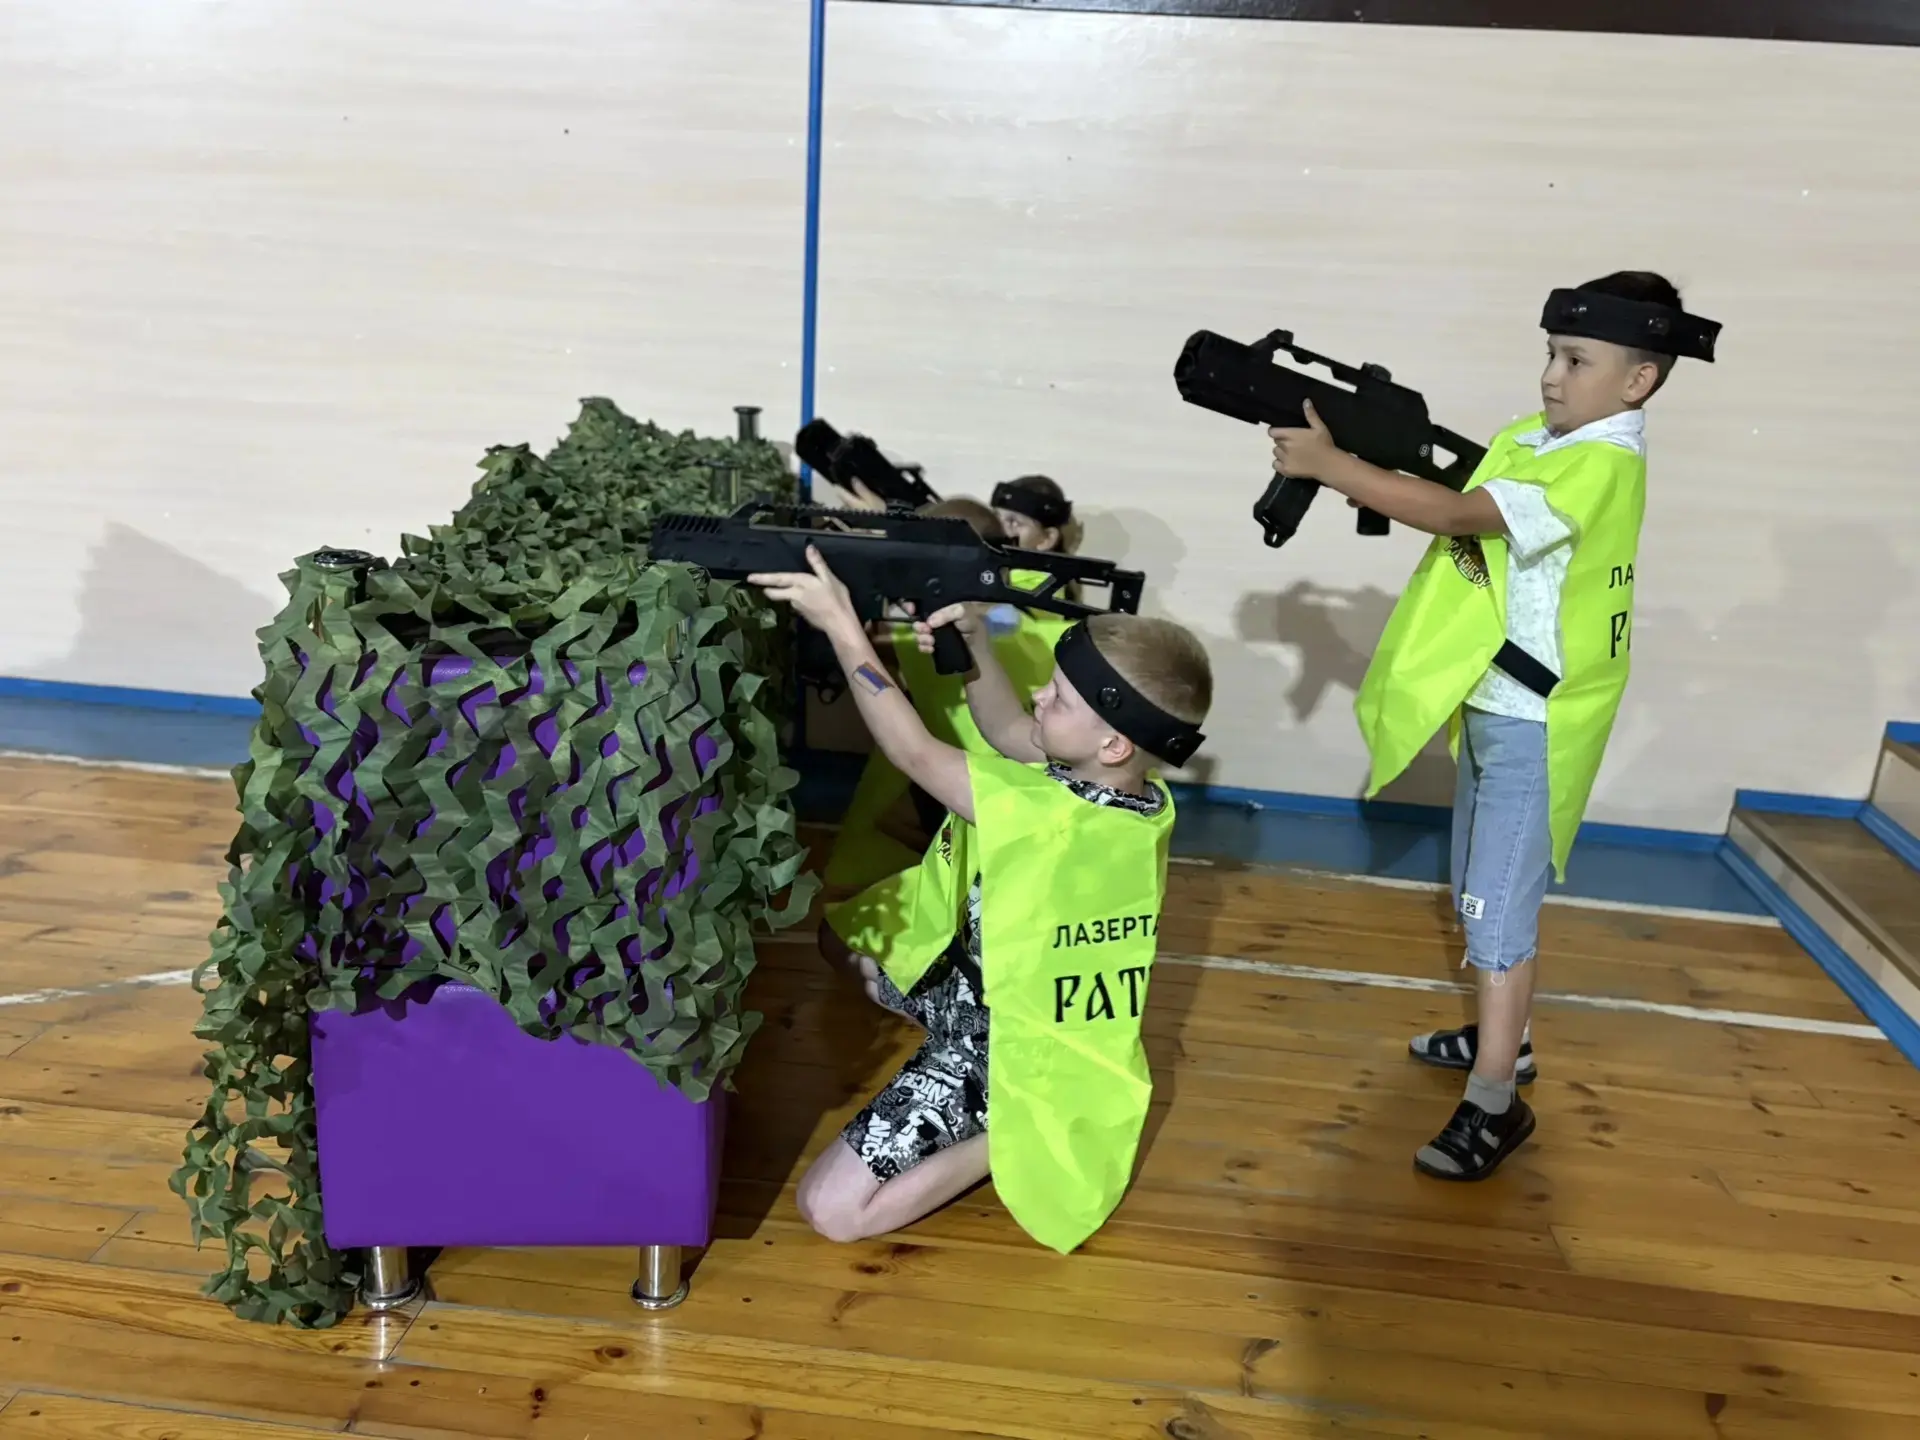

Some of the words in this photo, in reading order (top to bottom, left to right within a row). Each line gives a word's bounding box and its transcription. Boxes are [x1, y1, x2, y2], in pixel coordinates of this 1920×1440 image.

[1611, 611, 1632, 659] Р
[1465, 902, 1476, 915] 23
[1054, 965, 1153, 1023] РАТ
